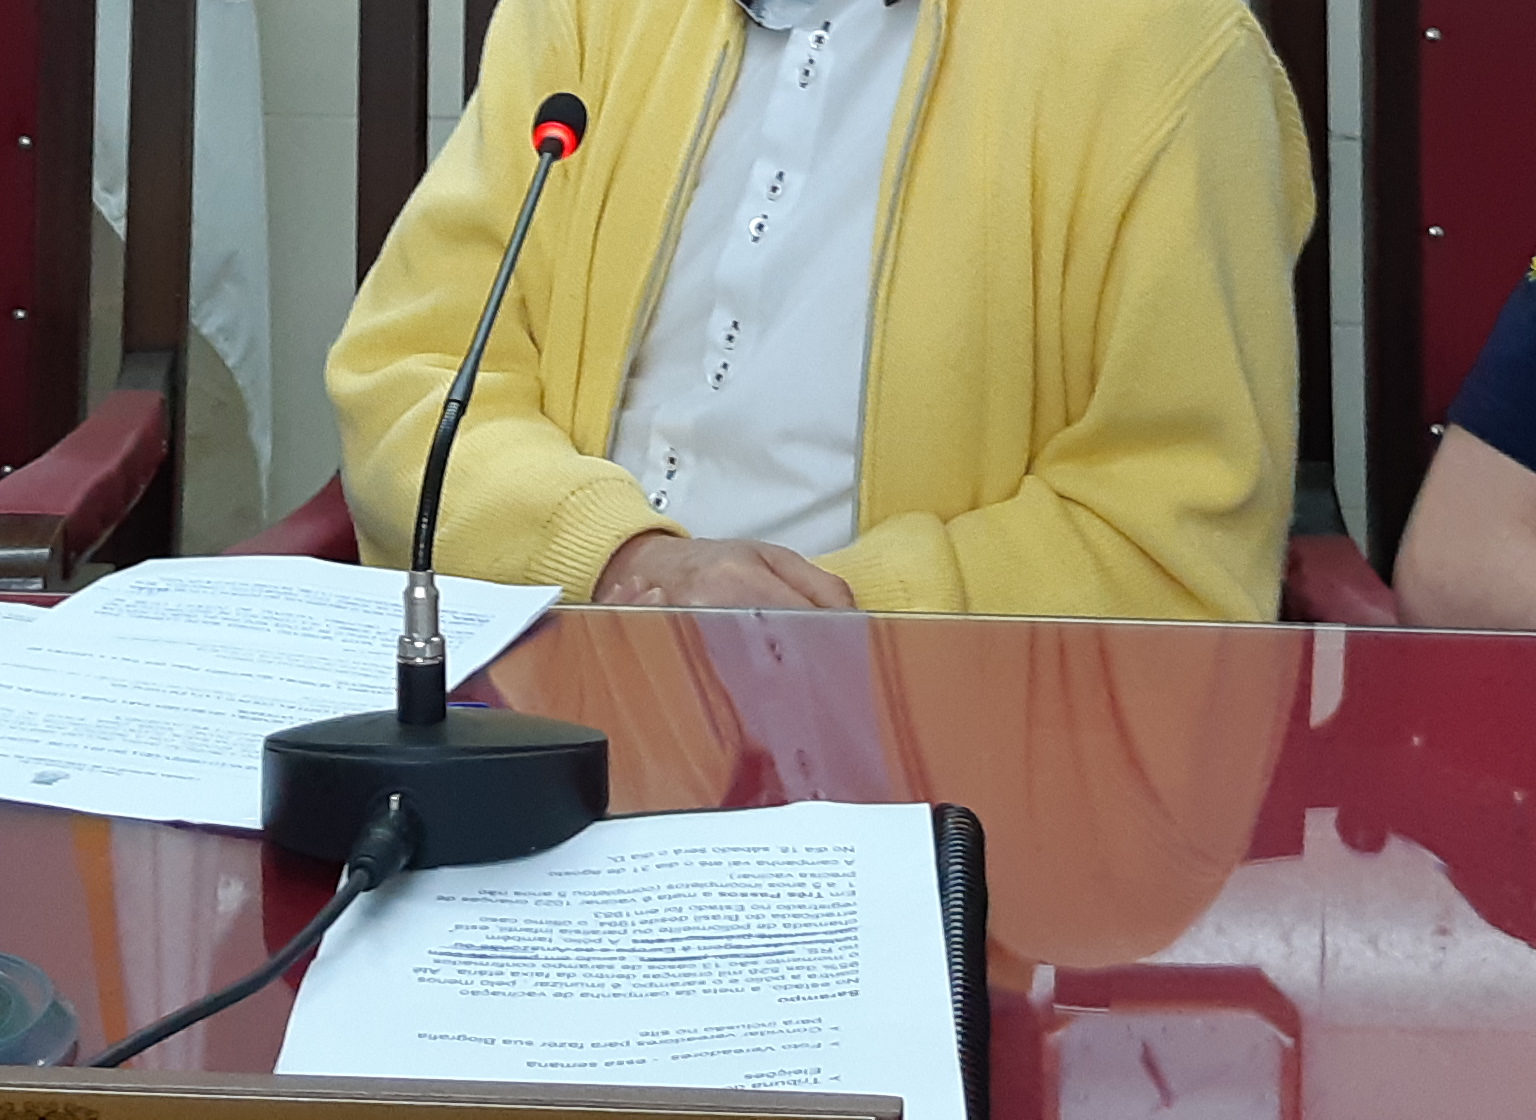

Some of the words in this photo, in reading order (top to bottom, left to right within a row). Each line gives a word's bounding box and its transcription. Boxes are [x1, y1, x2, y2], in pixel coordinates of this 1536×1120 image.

[755, 859, 840, 867] campanha
[548, 869, 602, 877] agosto
[798, 871, 857, 879] precisa
[666, 881, 762, 890] incompletos
[461, 897, 529, 905] crianças
[656, 892, 698, 901] meta
[688, 904, 746, 912] Estado
[776, 901, 858, 910] registrado
[693, 914, 740, 922] Brasil
[771, 910, 858, 920] erradicada
[479, 916, 518, 924] caso
[639, 915, 689, 926] desde
[782, 918, 858, 929] chamada
[484, 935, 553, 944] também
[432, 959, 537, 968] confirmados
[764, 955, 844, 964] momento
[509, 971, 551, 979] faixa
[582, 972, 637, 980] dentro
[642, 971, 714, 979] crianças
[806, 969, 860, 980] contra
[416, 977, 475, 986] menos
[480, 979, 517, 988] pelo
[458, 989, 547, 998] vacinação
[579, 991, 670, 999] campanha
[777, 990, 860, 1003] Sarampo
[782, 1017, 823, 1026] para
[703, 1021, 777, 1032] inclusão
[743, 1026, 823, 1037] Convidar
[416, 1033, 497, 1046] Biografia
[636, 1033, 736, 1046] vereadores
[539, 1042, 585, 1050] fazer
[590, 1040, 631, 1049] para
[781, 1042, 822, 1050] Foto
[670, 1046, 776, 1061] Vereadores
[603, 1058, 647, 1067] essa
[743, 1067, 822, 1080] Eleições
[750, 1077, 822, 1088] Tribuna
